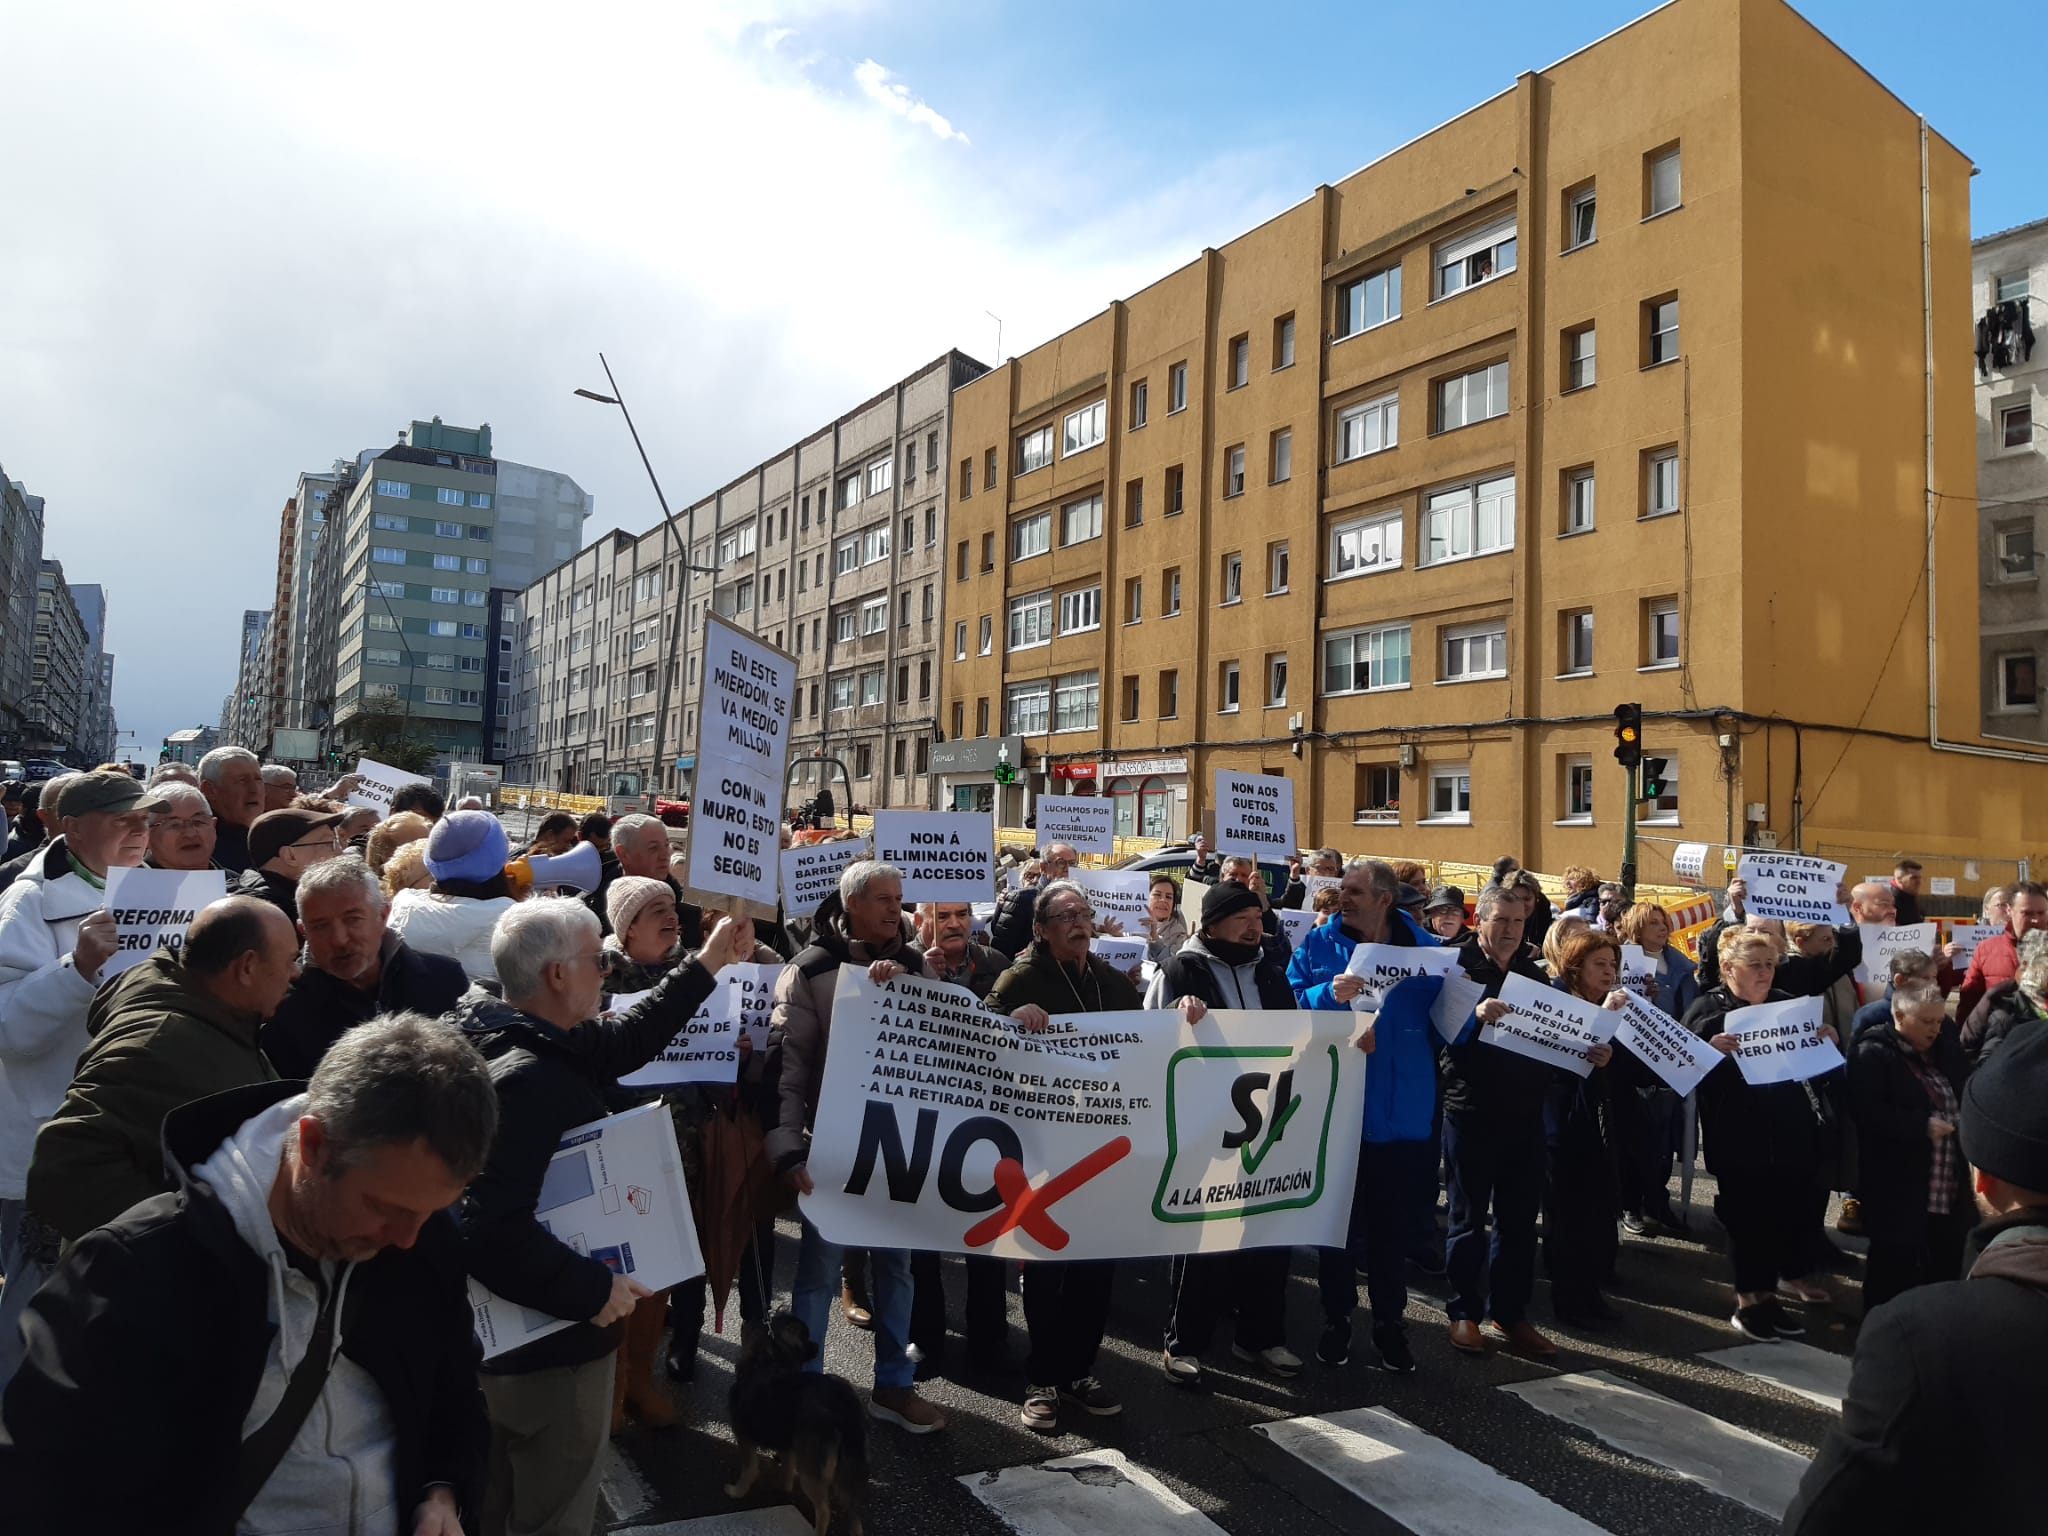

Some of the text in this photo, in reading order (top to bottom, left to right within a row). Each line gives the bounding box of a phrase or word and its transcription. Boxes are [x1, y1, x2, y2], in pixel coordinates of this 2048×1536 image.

[731, 649, 777, 687] EN ESTE
[774, 697, 786, 717] SE
[721, 696, 778, 736] VA MEDIO
[728, 724, 771, 757] MILLÓN
[358, 788, 381, 802] ERO
[721, 778, 766, 808] CON UN
[1231, 782, 1279, 798] NON AOS
[1044, 805, 1091, 815] LUCHAMOS
[1232, 797, 1278, 815] GUETOS,
[702, 799, 775, 836] MURO, ESTO
[1241, 812, 1270, 827] FÓRA
[1044, 823, 1106, 833] ACCESIBILIDAD
[1226, 828, 1286, 844] BARREIRAS
[723, 831, 759, 855] NO ES
[911, 830, 960, 845] NON Á
[1052, 832, 1099, 842] UNIVERSAL
[797, 850, 852, 867] NO A LAS
[883, 848, 988, 863] ELIMINACIÓN
[1749, 855, 1837, 871] RESPETEN A
[713, 854, 761, 882] SEGURO
[795, 863, 843, 879] BARRER
[911, 868, 986, 880] ACCESOS
[1757, 868, 1827, 883] LA GENTE
[795, 877, 836, 891] CONTR
[1776, 883, 1807, 895] CON
[1135, 892, 1148, 901] AL
[1751, 895, 1832, 910] MOVILIDAD
[1090, 899, 1142, 912] CINDARIO
[112, 908, 195, 925] REFORMA
[1757, 907, 1832, 922] REDUCIDA
[117, 934, 151, 951] ERO
[1877, 928, 1920, 941] ACCESO
[1114, 952, 1137, 960] POR
[1375, 964, 1411, 977] NON
[758, 982, 769, 994] A
[885, 981, 896, 992] A
[900, 983, 922, 998] UN
[926, 989, 972, 1008] MURO
[882, 998, 893, 1009] A
[897, 1000, 927, 1014] LAS
[1532, 1000, 1583, 1026] NO A LA
[714, 1021, 730, 1032] DE
[1507, 1003, 1600, 1043] SUPRESIÓN DE
[1649, 1008, 1689, 1043] CONTRA
[880, 1014, 890, 1025] A
[895, 1016, 914, 1029] LA
[918, 1020, 1020, 1050] ELIMINACIÓN
[1024, 1041, 1042, 1053] DE
[1101, 1049, 1120, 1060] DE
[1535, 1027, 1560, 1040] LOS
[1623, 1013, 1676, 1062] BOMBEROS
[1677, 1060, 1686, 1069] Y
[1626, 1002, 1695, 1067] AMBULANCIAS,
[1735, 1024, 1799, 1043] REFORMA
[877, 1031, 997, 1062] APARCAMIENTO
[1632, 1035, 1661, 1063] TAXIS
[1776, 1040, 1796, 1052] NO
[874, 1048, 1121, 1092] A LA ELIMINACIÓN DEL ACCESO A
[872, 1064, 1151, 1110] AMBULANCIAS, BOMBEROS, TAXIS, ETC.
[869, 1082, 1131, 1125] A LA RETIRADA DE CONTENEDORES.
[844, 1099, 1024, 1213] NO
[1167, 1168, 1311, 1206] A LA REHABILITACIÓN
